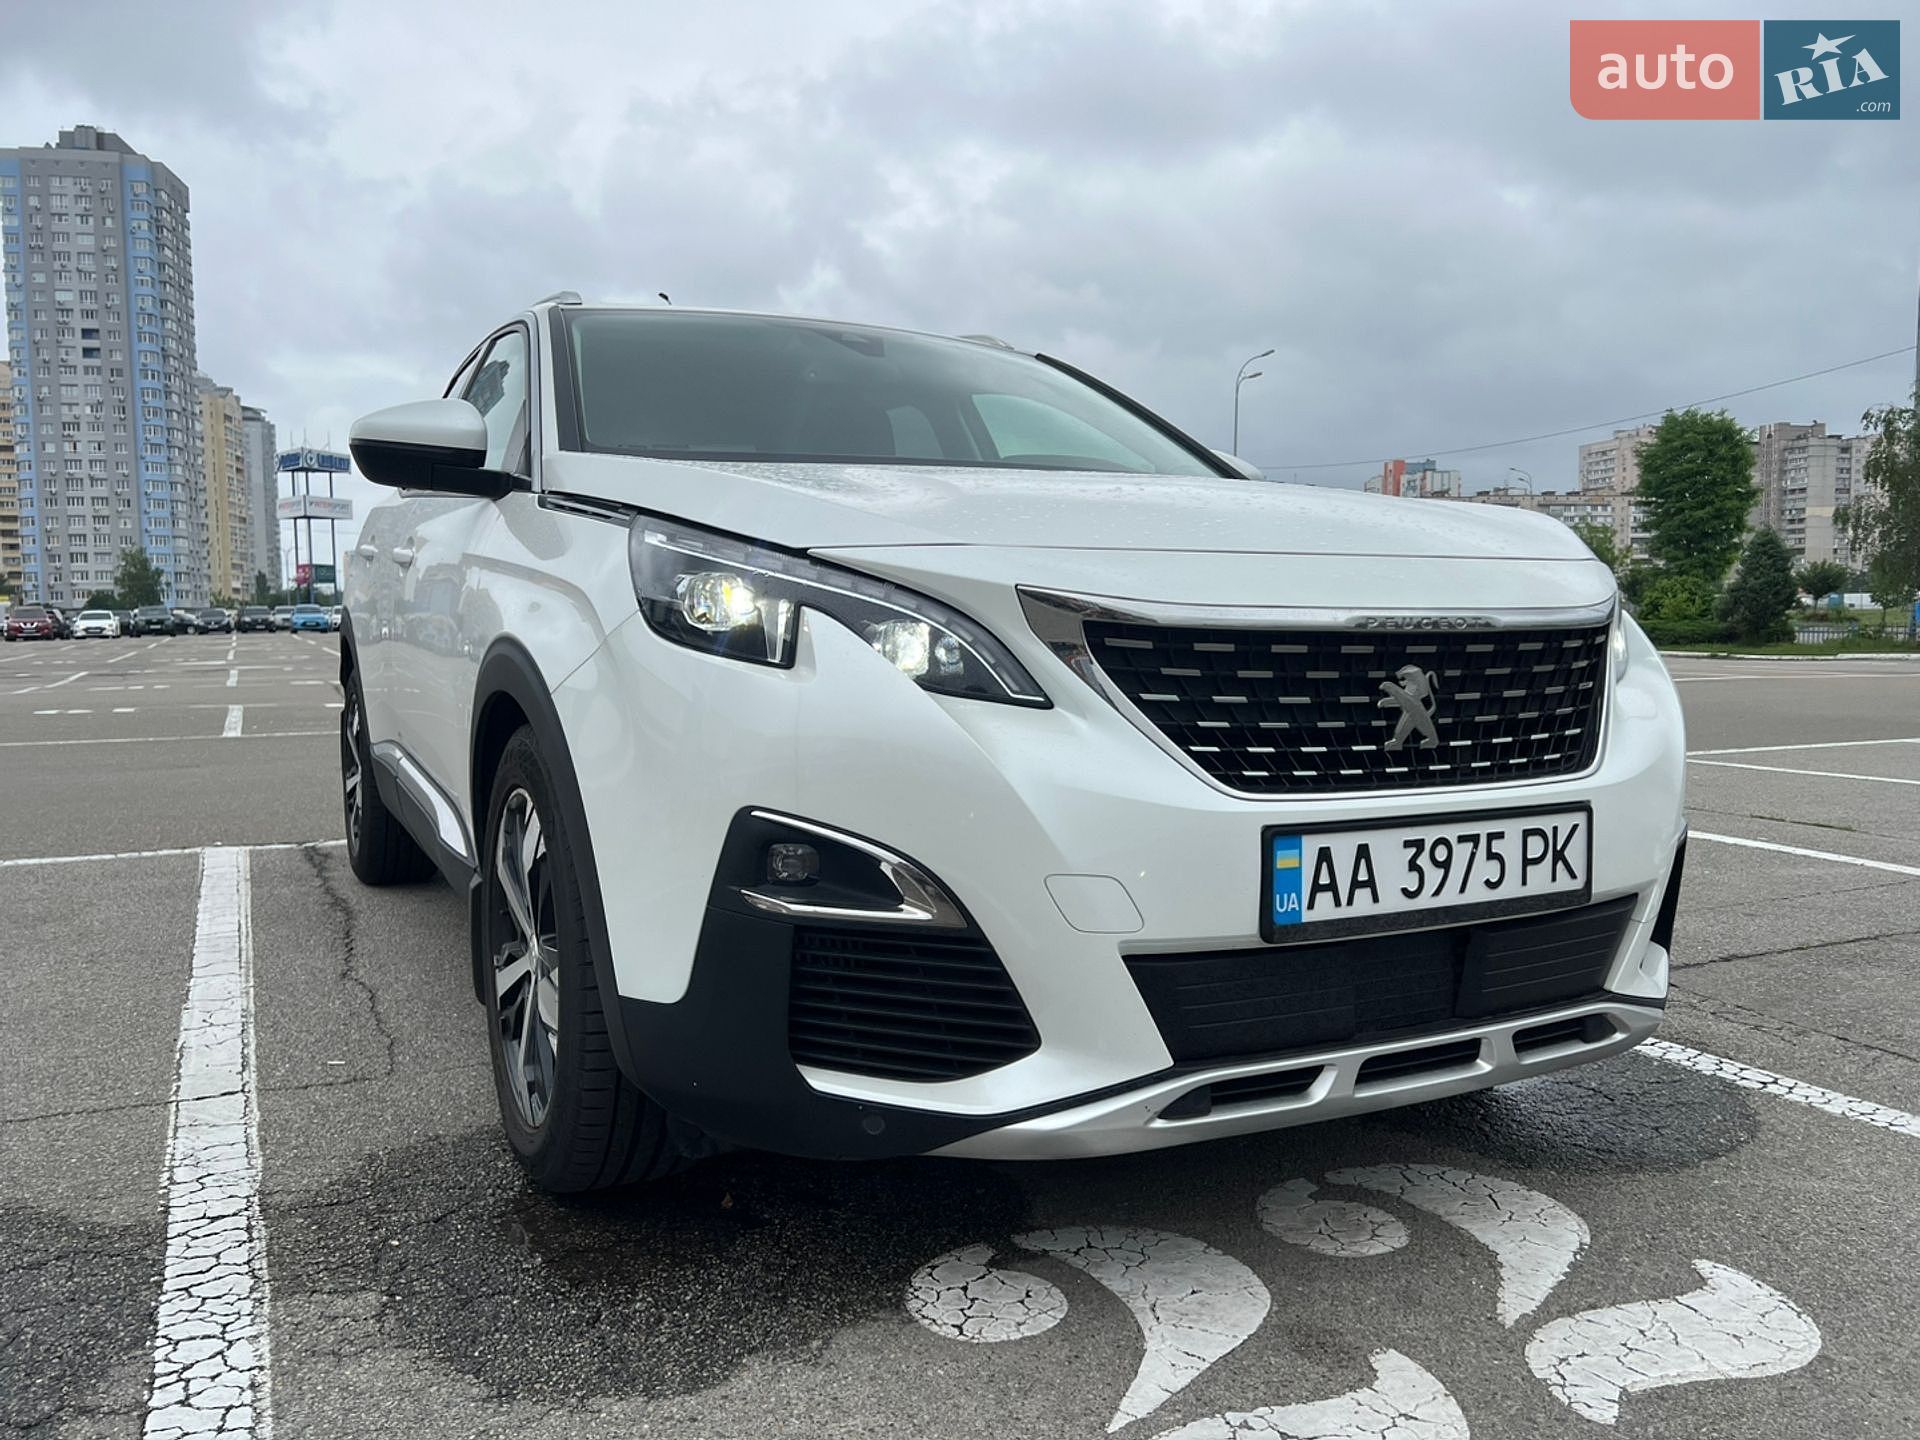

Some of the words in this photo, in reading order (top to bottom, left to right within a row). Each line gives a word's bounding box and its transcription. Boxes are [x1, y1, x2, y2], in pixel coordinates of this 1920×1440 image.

[1366, 616, 1482, 630] PEUGEOT
[1306, 842, 1380, 911] AA
[1400, 830, 1506, 900] 3975
[1521, 823, 1580, 887] PK
[1275, 892, 1300, 913] UA
